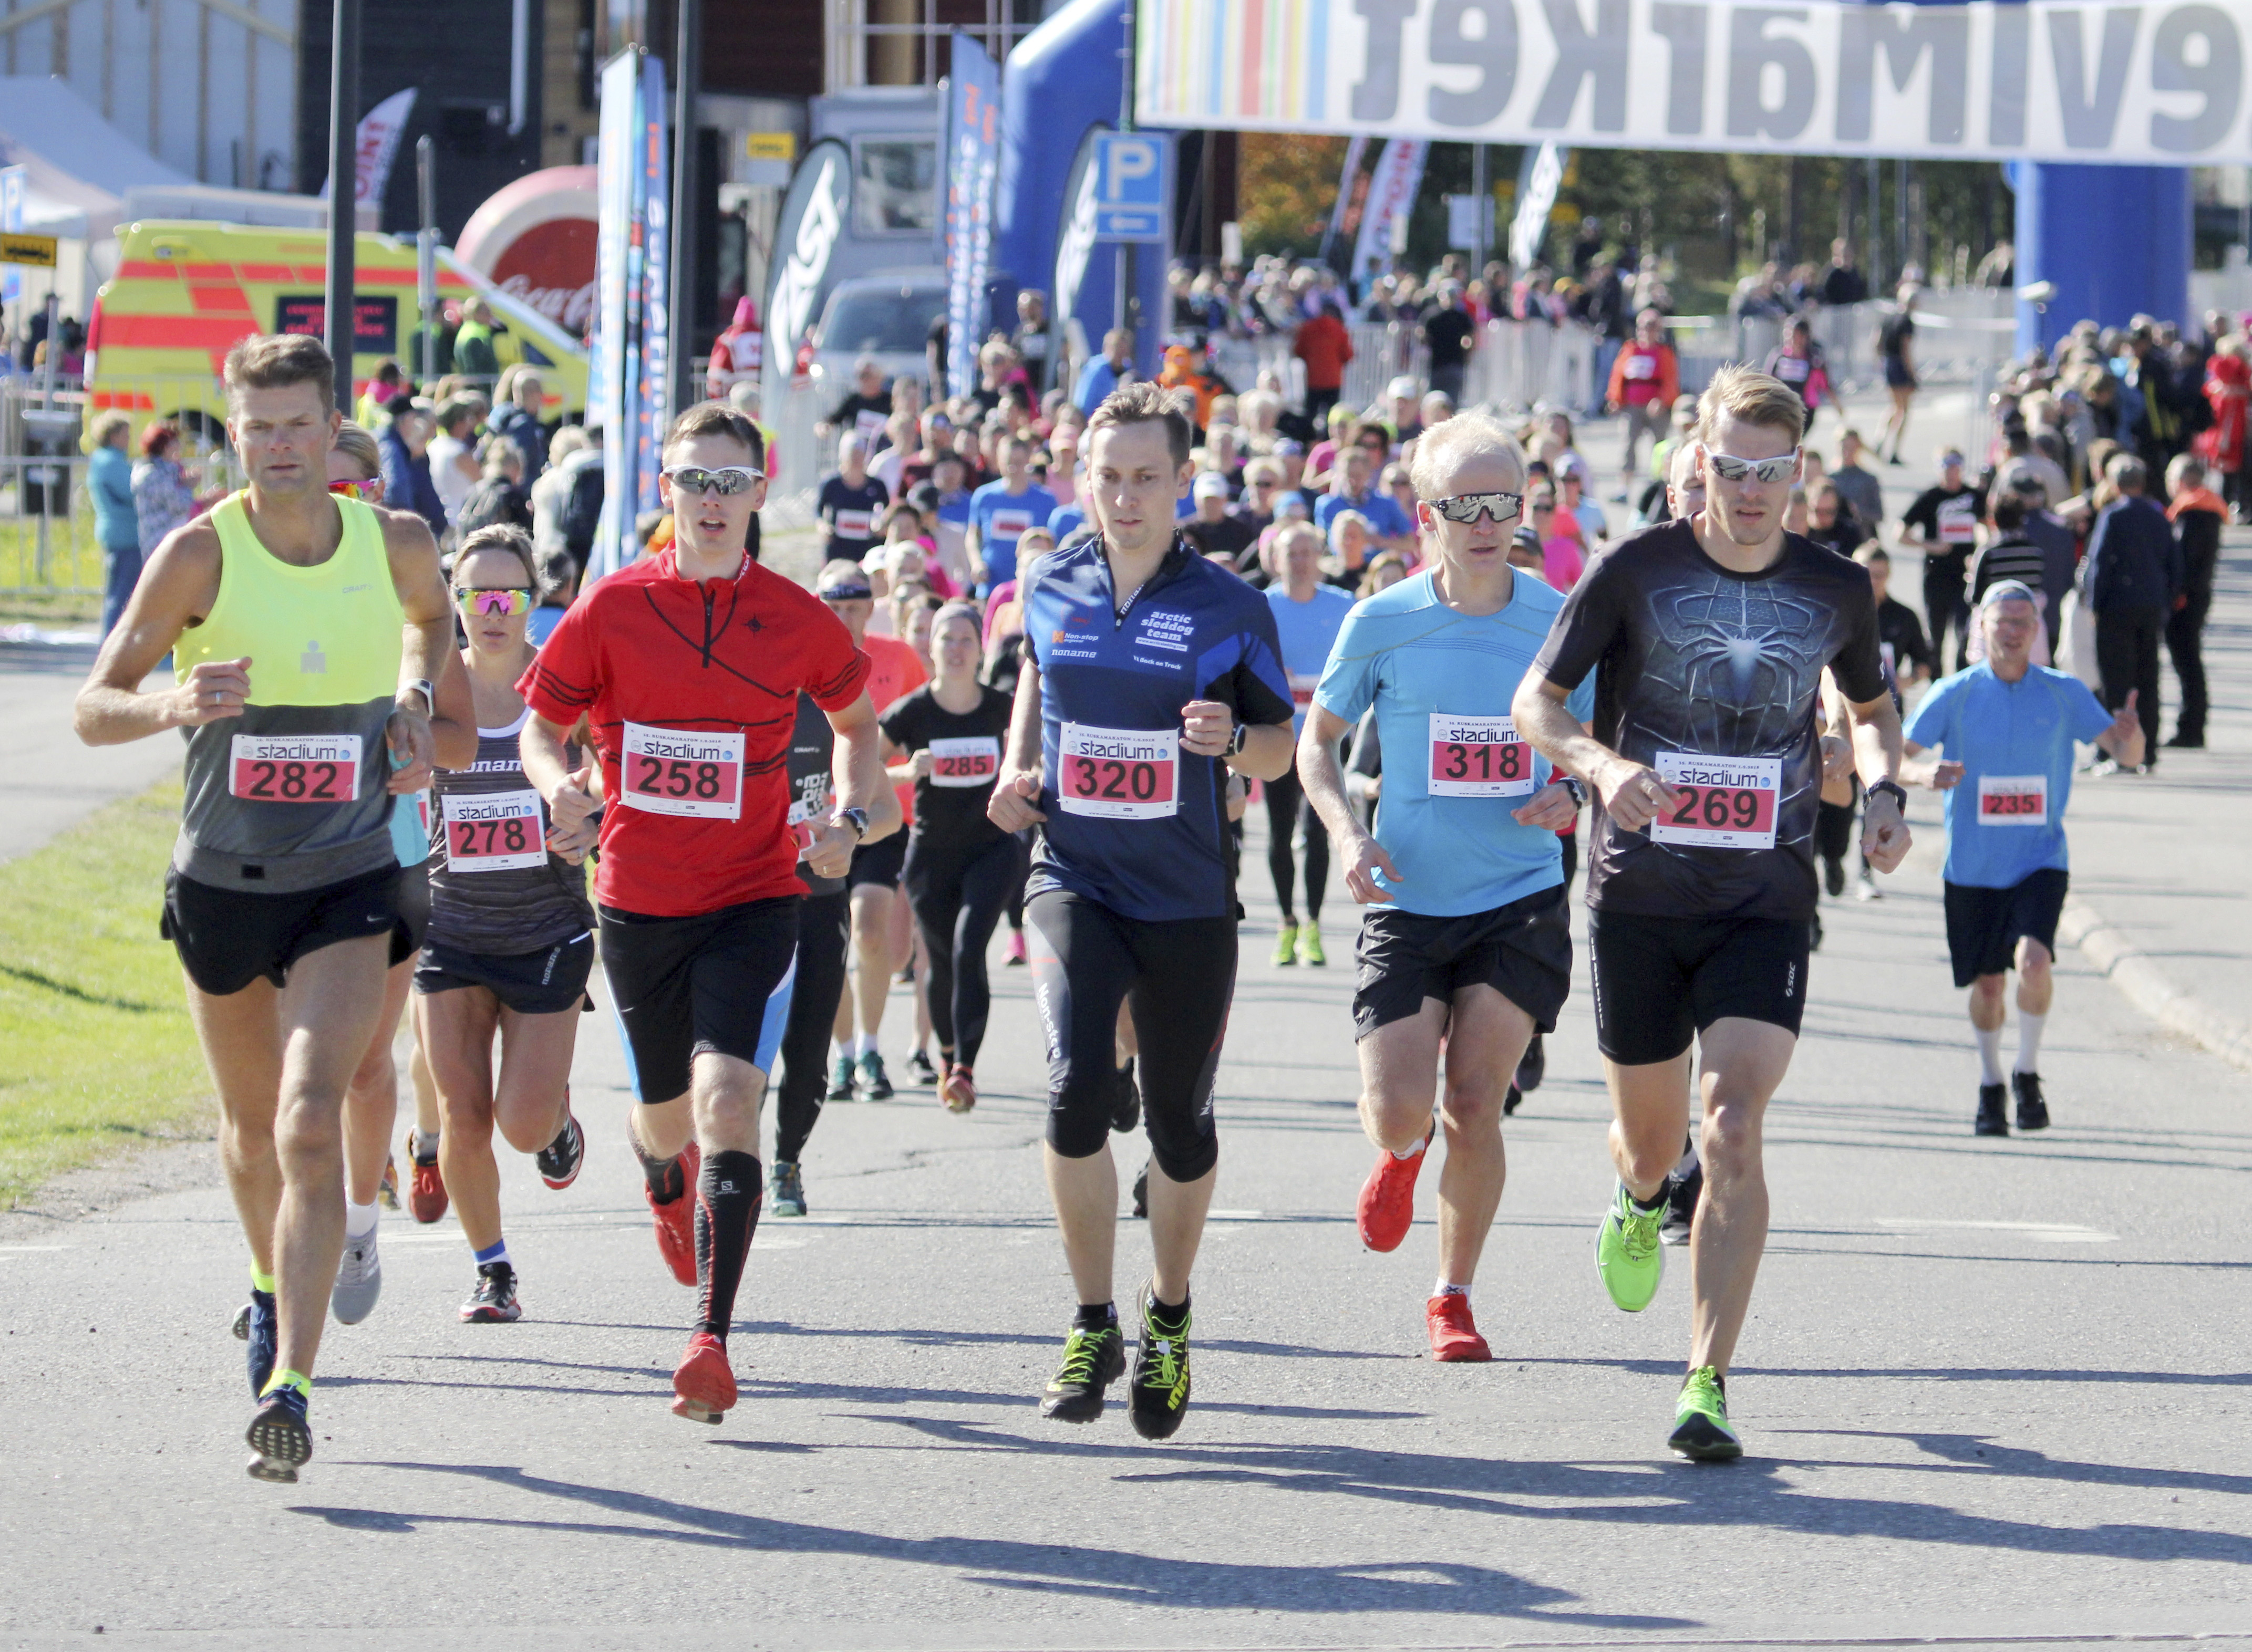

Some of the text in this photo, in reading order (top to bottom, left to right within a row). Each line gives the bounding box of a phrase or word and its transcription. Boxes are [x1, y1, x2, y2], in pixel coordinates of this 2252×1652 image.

[1108, 141, 1153, 200] P
[1141, 618, 1194, 636] sleddog
[1151, 611, 1192, 624] arctic
[1065, 633, 1099, 641] Non-stop
[1146, 629, 1182, 641] team
[1051, 649, 1097, 658] noname
[1450, 728, 1518, 742] stadium
[256, 744, 336, 760] stadium
[644, 741, 719, 760] stadium
[1080, 741, 1154, 759] stadium
[943, 756, 986, 776] 285
[1446, 744, 1519, 778] 318
[249, 762, 336, 798] 282
[638, 757, 719, 799] 258
[1075, 759, 1156, 800] 320
[1679, 768, 1758, 787] stadium
[459, 805, 520, 819] stadium
[1672, 786, 1758, 828] 269
[1991, 795, 2034, 814] 235
[458, 819, 525, 854] 278
[542, 947, 561, 985] noname
